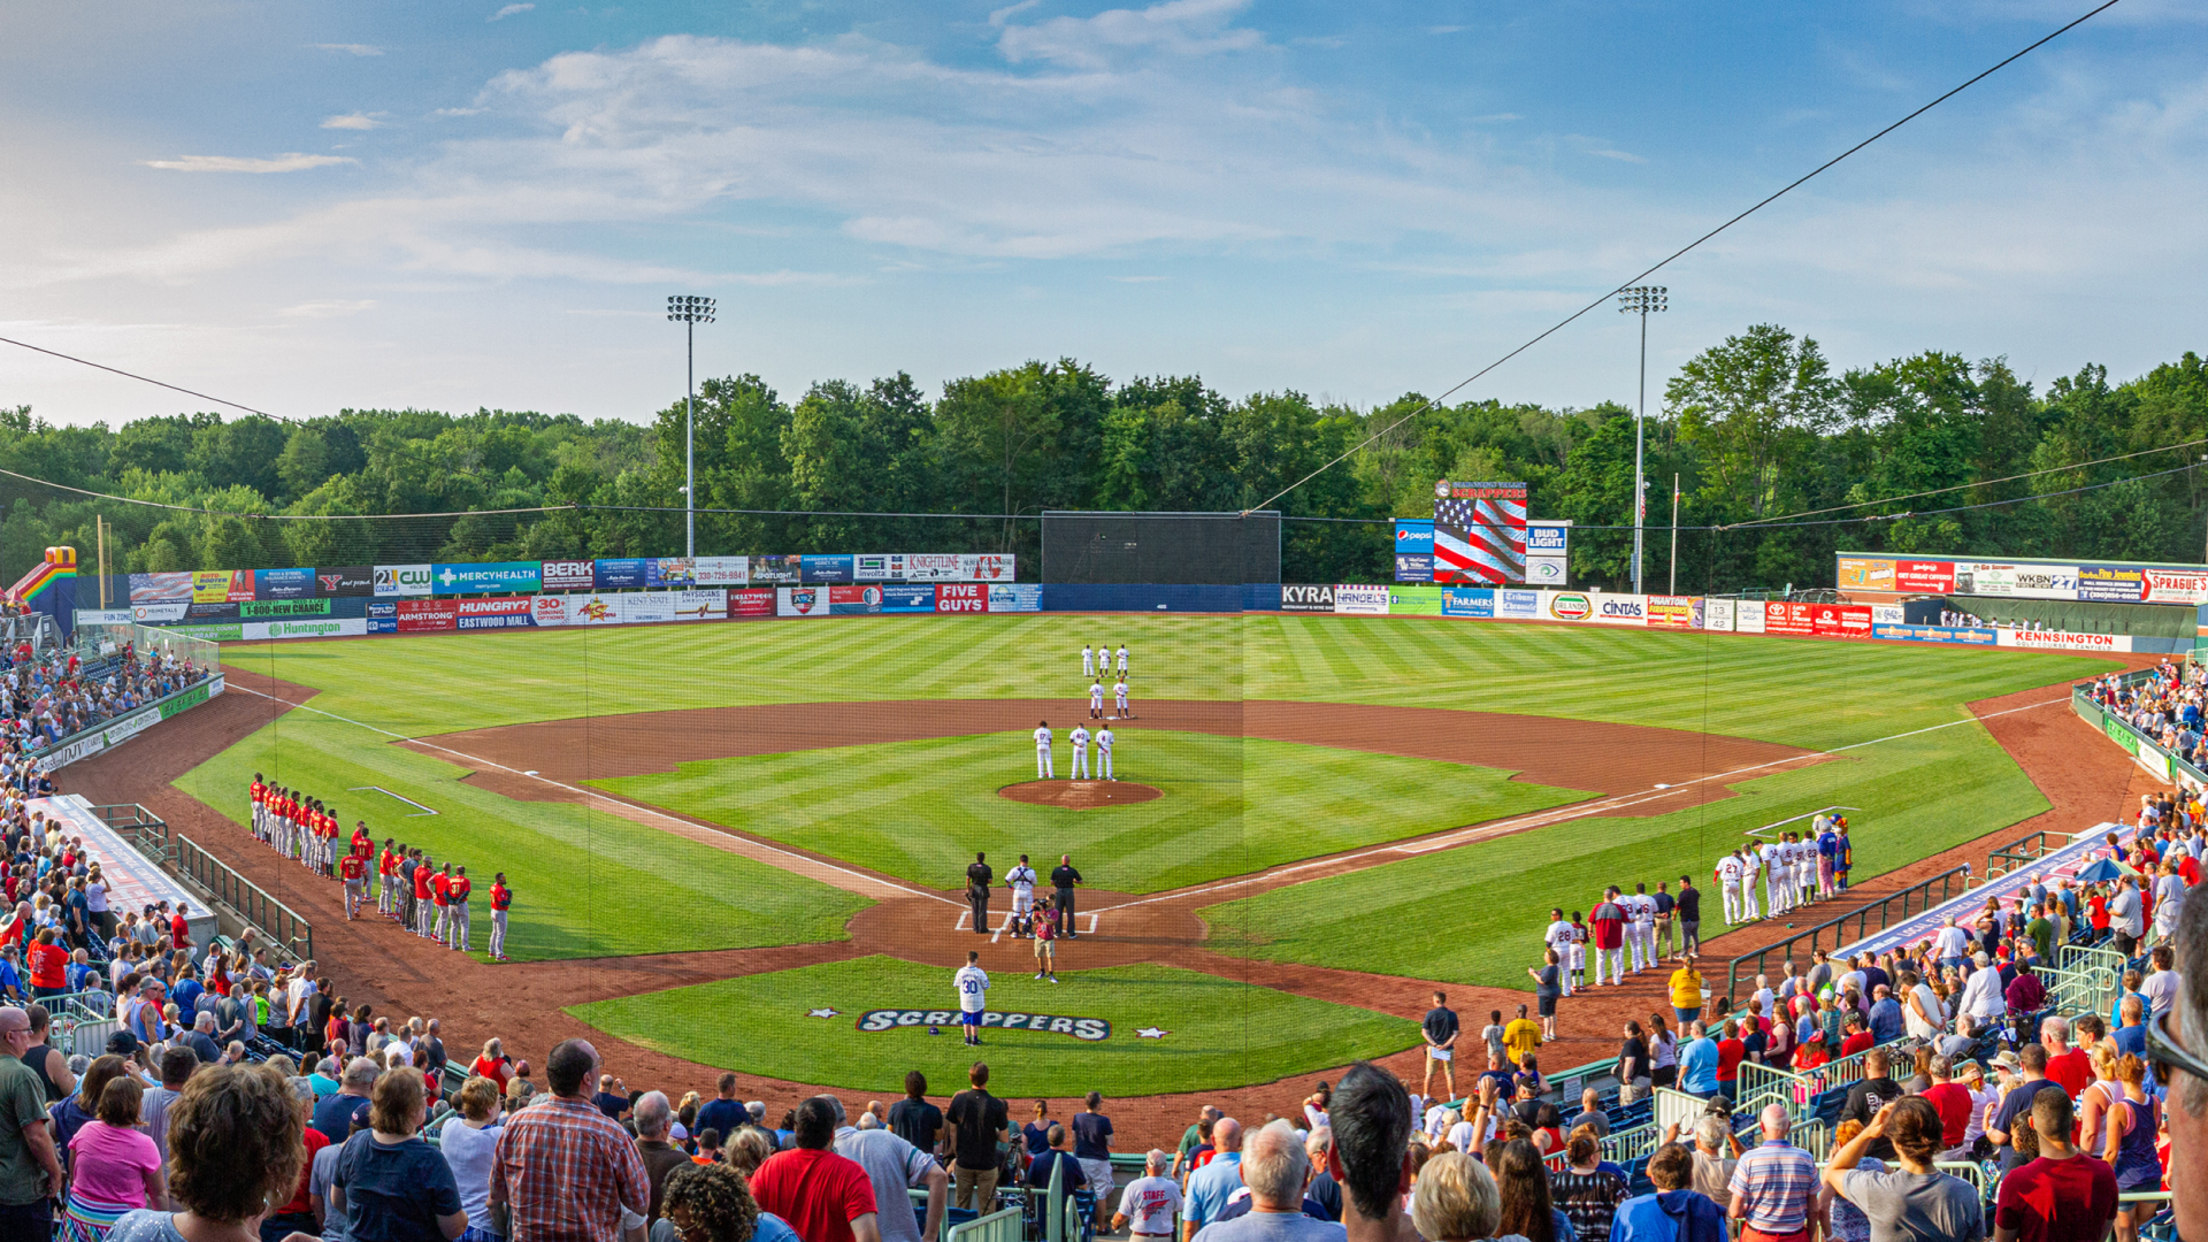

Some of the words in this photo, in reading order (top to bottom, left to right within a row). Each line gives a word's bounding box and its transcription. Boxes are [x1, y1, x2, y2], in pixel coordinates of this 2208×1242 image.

[1452, 488, 1527, 498] SCRAPPERS
[1409, 531, 1432, 541] pepsi
[1534, 528, 1559, 538] BUD
[1529, 538, 1564, 547] LIGHT
[909, 555, 959, 570] KNIGHTLINE
[543, 562, 593, 576] BERK
[375, 570, 393, 584] 21
[2017, 574, 2051, 583] WKBN
[2052, 575, 2077, 590] 27
[2153, 576, 2207, 590] SPRAGUE'S
[681, 590, 721, 598] PHYSICIANS
[942, 585, 977, 597] FIVE
[1282, 586, 1333, 603] KYRA
[1505, 593, 1535, 601] Tribune
[537, 598, 565, 609] 30+
[1337, 592, 1387, 604] HANDEL'S
[1453, 597, 1494, 607] FARMERS
[1649, 596, 1689, 607] PHANTOM
[246, 604, 291, 615] 1-800-NEW
[293, 603, 324, 613] CHANCE
[459, 600, 530, 613] HUNGRY?
[939, 599, 982, 611] GUYS
[1555, 602, 1588, 611] ORLANDO
[1603, 600, 1642, 616] CINTAS
[1714, 606, 1725, 614] 13
[104, 613, 115, 621] FUN
[116, 613, 131, 621] ZONE
[399, 612, 453, 621] ARMSTRONG
[459, 615, 505, 628] EASTWOOD
[506, 614, 529, 626] MALL
[283, 622, 341, 636] Huntington
[2015, 631, 2113, 645] KENNSINGTON
[64, 743, 85, 762] DJV
[1807, 849, 1817, 858] 23
[350, 865, 355, 874] 3
[451, 884, 460, 894] 31
[1900, 922, 1934, 938] LOCAL
[1930, 900, 1980, 925] ELECTRICAL
[1558, 930, 1571, 942] 28
[963, 979, 978, 994] 30
[1143, 1190, 1165, 1200] STAFF
